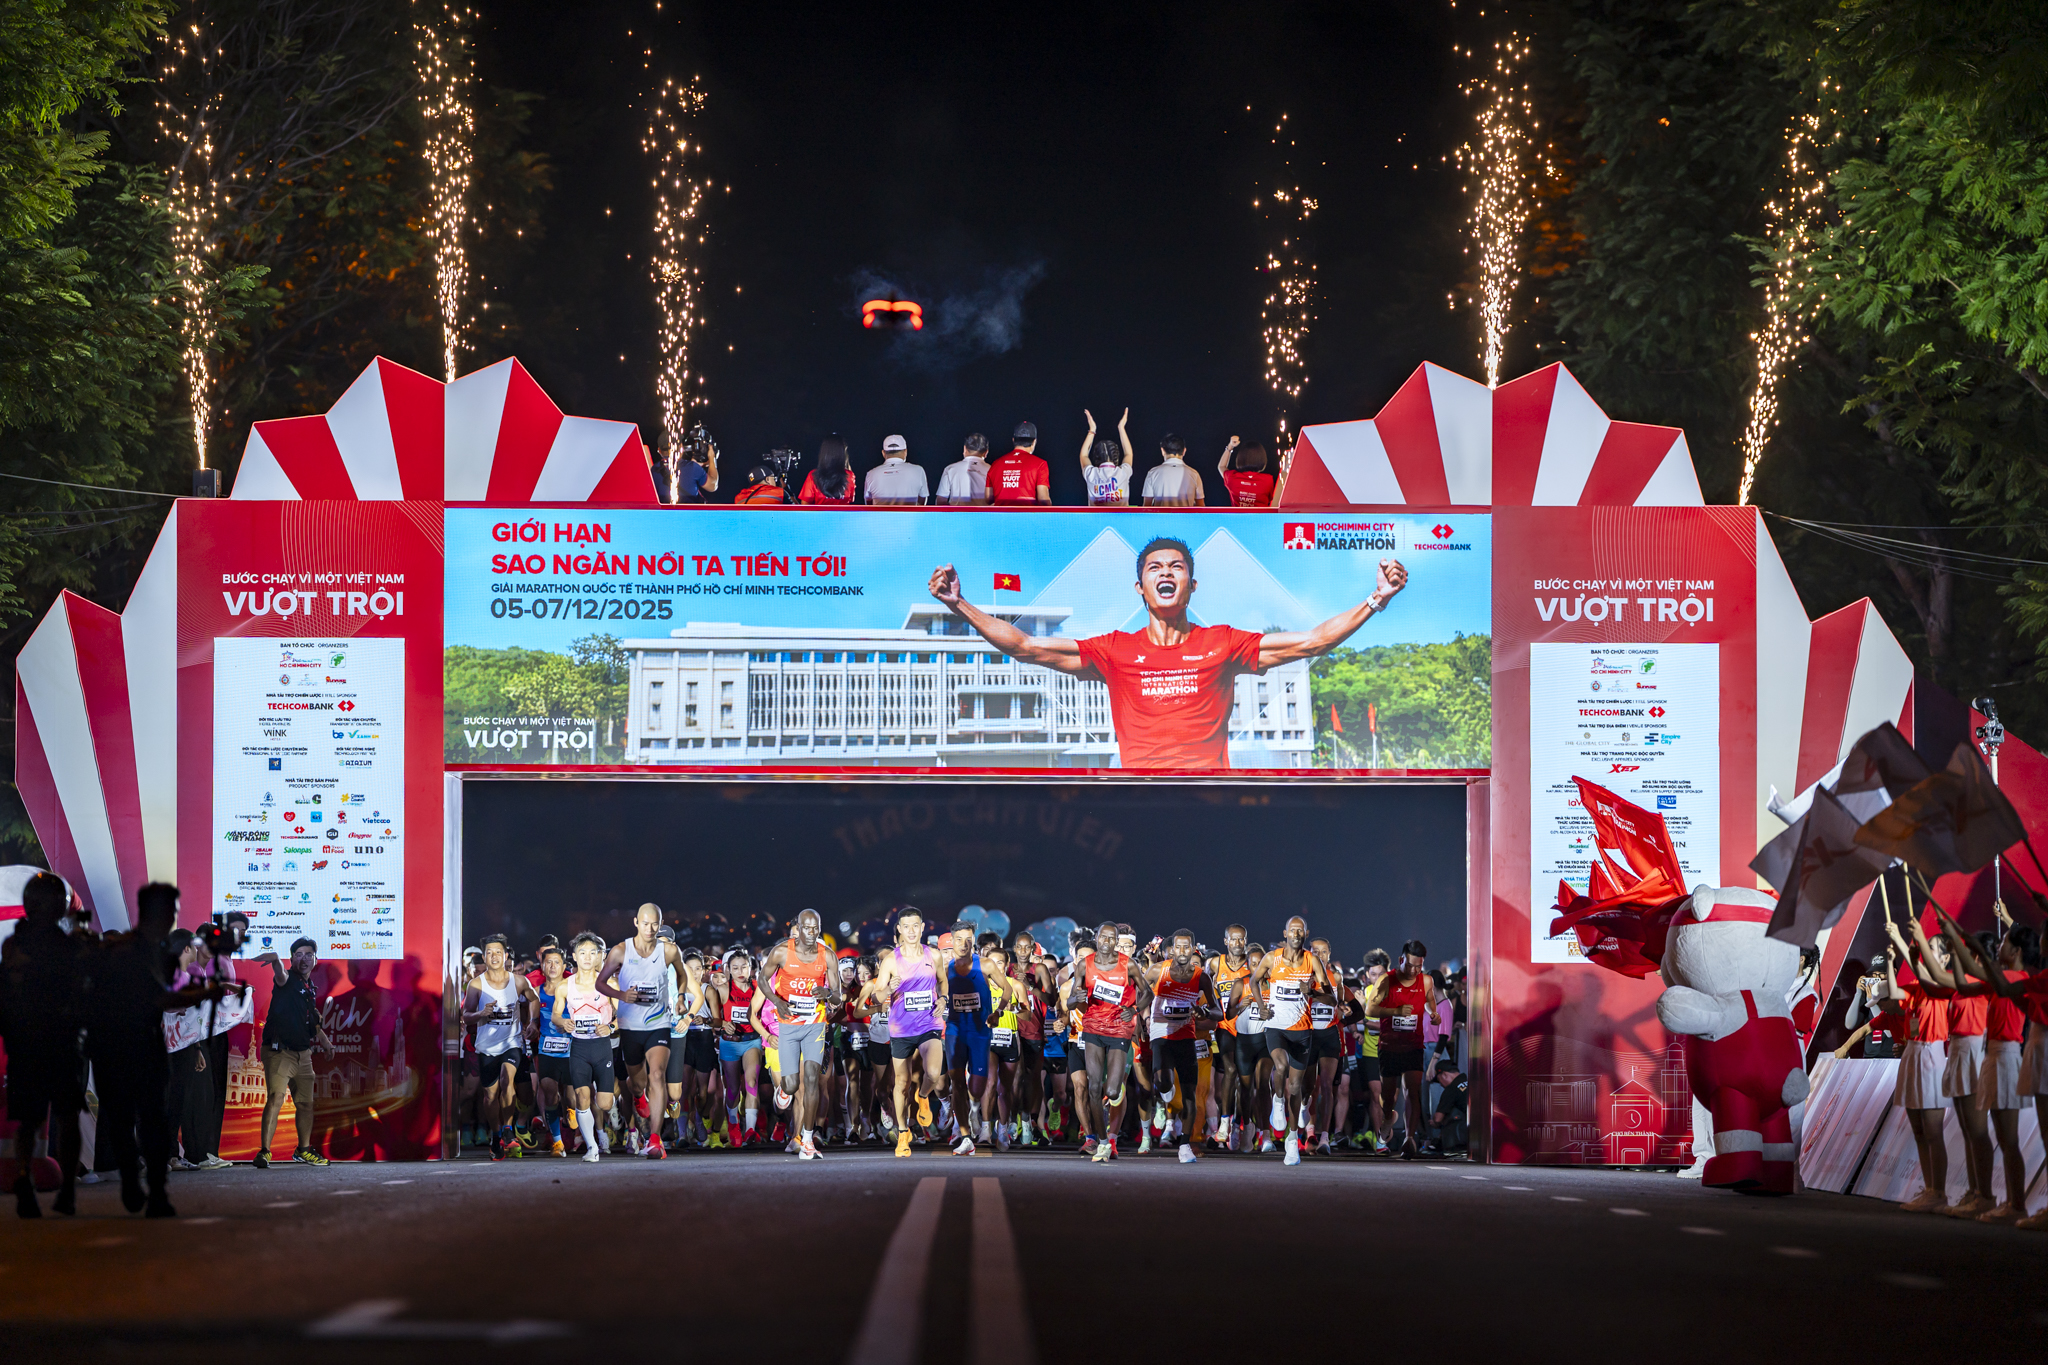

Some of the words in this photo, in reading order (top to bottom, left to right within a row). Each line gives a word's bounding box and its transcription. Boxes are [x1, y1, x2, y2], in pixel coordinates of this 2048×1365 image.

[1094, 477, 1118, 496] HCMC
[492, 517, 546, 543] GIỚI
[554, 522, 611, 549] HẠN
[1317, 523, 1370, 531] HOCHIMINH
[1373, 523, 1395, 531] CITY
[1317, 538, 1395, 550] MARATHON
[492, 554, 546, 575] SAO
[553, 551, 630, 576] NGĂN
[637, 551, 684, 576] NỔI
[691, 555, 724, 576] TA
[731, 551, 788, 577] TIẾN
[795, 551, 846, 577] TỚI!
[223, 572, 258, 584] BƯỚC
[262, 574, 296, 586] CHẠY
[299, 572, 310, 584] VÌ
[314, 572, 342, 586] MỘT
[345, 572, 372, 586] VIỆT
[376, 574, 404, 584] NAM
[1534, 577, 1569, 590] BƯỚC
[1573, 580, 1607, 592] CHẠY
[1610, 578, 1622, 589] VÌ
[1625, 578, 1653, 592] MỘT
[1656, 578, 1683, 592] VIỆT
[1686, 580, 1714, 590] NAM
[491, 581, 512, 594] GIẢI
[515, 583, 580, 594] MARATHON
[582, 581, 616, 595] QUỐC
[619, 581, 632, 595] TẾ
[635, 581, 674, 595] THÀNH
[677, 581, 700, 595] PHỐ
[704, 581, 720, 595] HỒ
[723, 582, 743, 595] CHÍ
[745, 585, 774, 596] MINH
[777, 585, 863, 596] TECHCOMBANK
[222, 587, 318, 621] VƯỢT
[327, 586, 404, 621] TRỘI
[491, 599, 673, 620] 05-07/12/2025
[1534, 593, 1628, 627] VƯỢT
[1637, 593, 1713, 627] TRỘI
[1142, 686, 1198, 696] MARATHON
[464, 715, 492, 726] BƯỚC
[493, 717, 517, 728] CHẠY
[518, 715, 528, 726] VÌ
[530, 716, 551, 728] MỘT
[553, 716, 573, 728] VIỆT
[575, 717, 595, 726] NAM
[332, 730, 344, 739] be
[463, 726, 532, 752] VƯỢT
[538, 726, 594, 752] TRỘI
[1608, 764, 1640, 773] XTEP
[248, 863, 258, 871] ila
[337, 1032, 362, 1042] PHỐ
